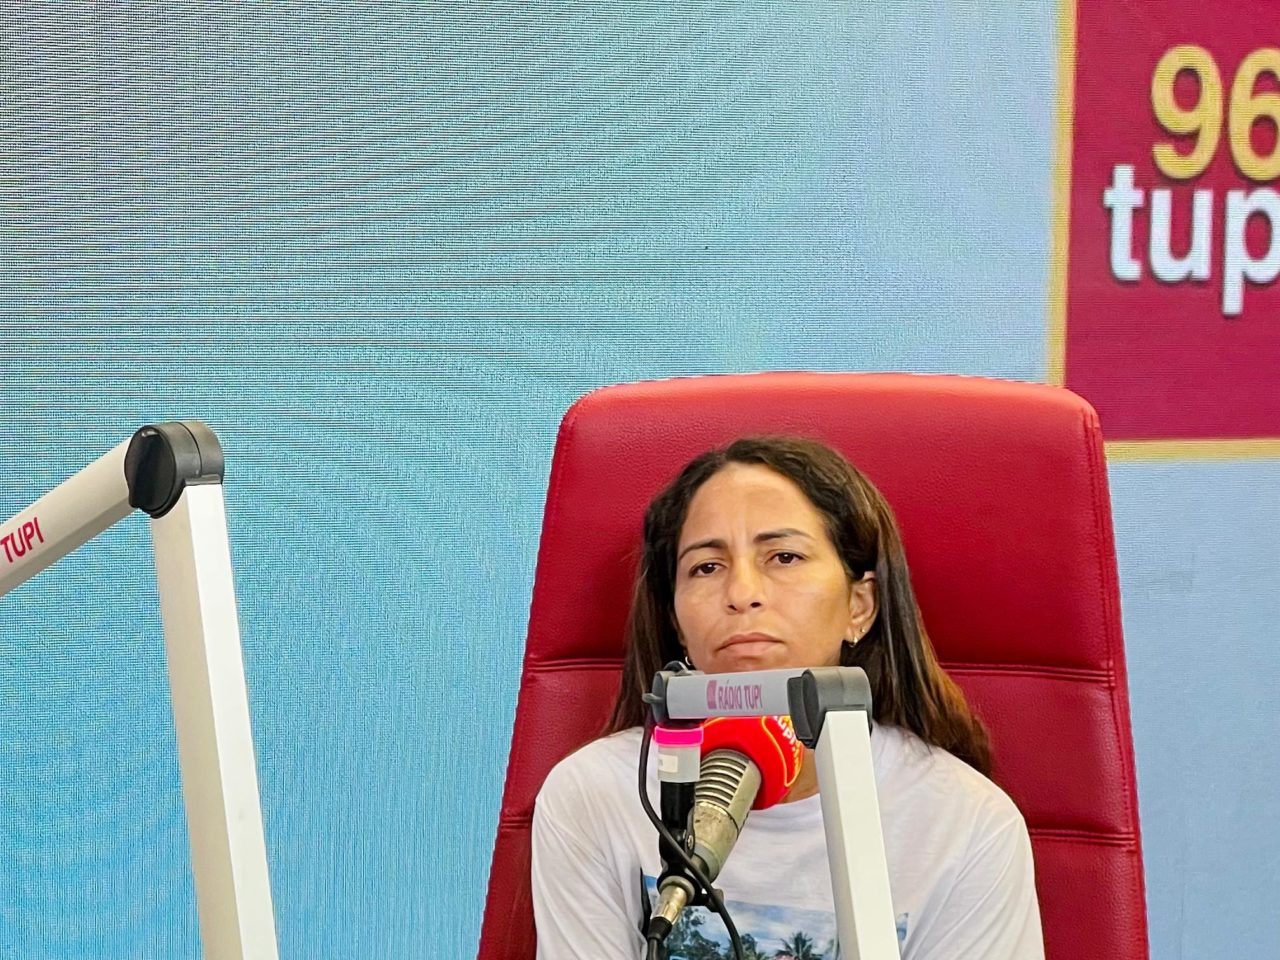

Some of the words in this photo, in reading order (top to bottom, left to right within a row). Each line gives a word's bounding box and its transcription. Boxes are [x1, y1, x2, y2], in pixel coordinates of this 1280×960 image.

[1102, 163, 1280, 316] tup
[0, 517, 44, 563] TUPI
[718, 680, 743, 710] RÁDIO
[744, 684, 763, 709] TUPI
